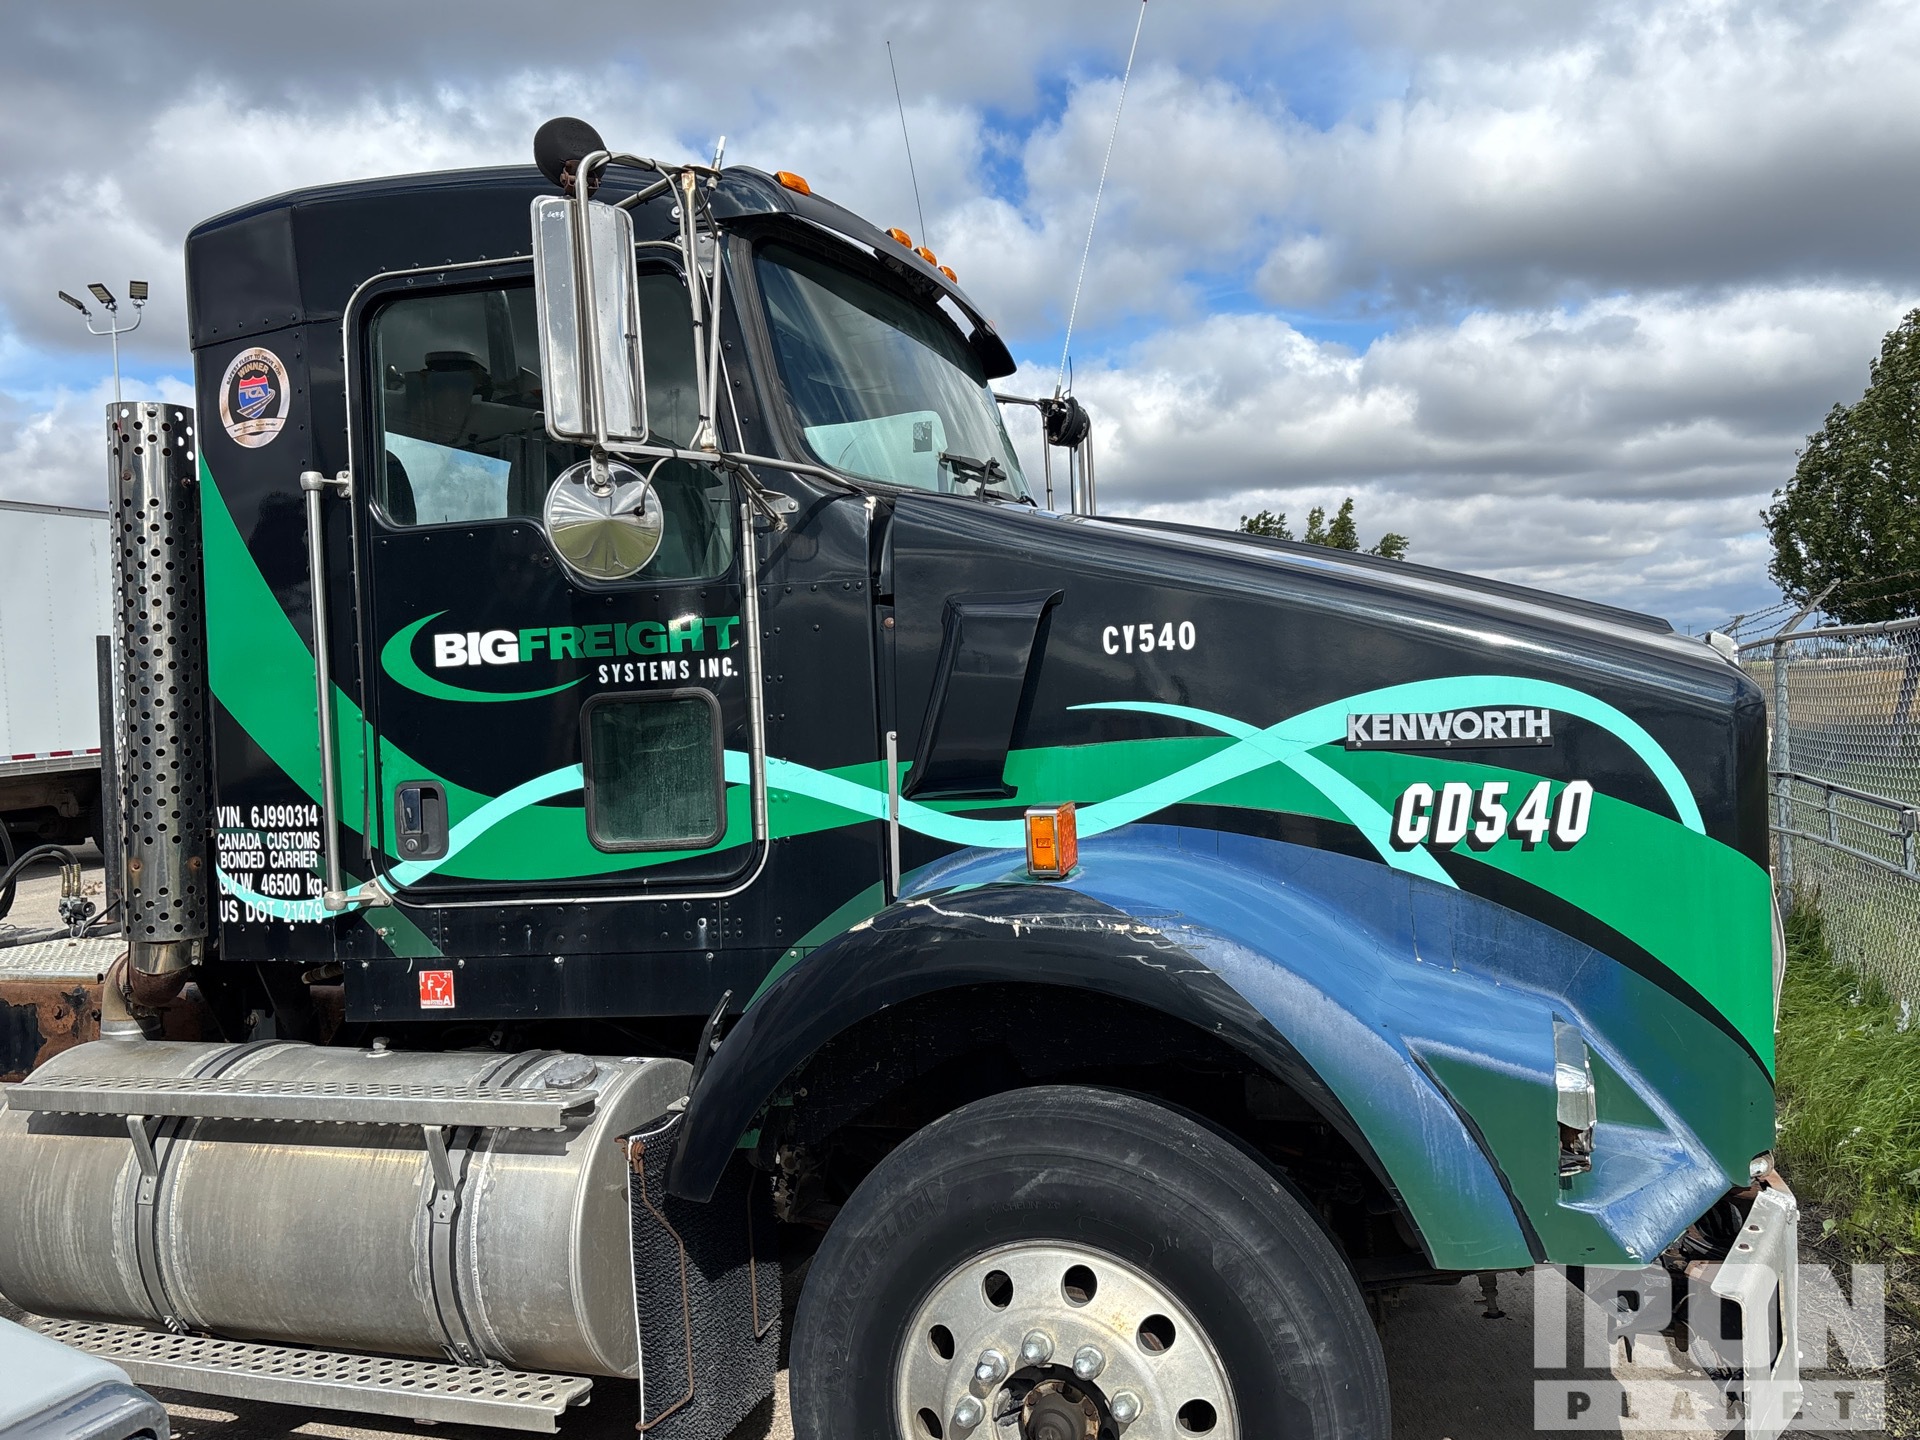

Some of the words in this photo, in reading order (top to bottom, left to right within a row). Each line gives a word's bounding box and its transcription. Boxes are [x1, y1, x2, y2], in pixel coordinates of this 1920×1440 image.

[237, 361, 269, 378] WINNER
[239, 386, 266, 400] TCA
[1102, 620, 1197, 656] CY540
[598, 660, 690, 684] SYSTEMS
[699, 656, 739, 678] INC.
[1347, 708, 1550, 742] KENWORTH
[216, 805, 245, 828] VIN.
[251, 804, 318, 828] 6J990314
[1393, 780, 1594, 850] CD540
[217, 832, 262, 851] CANADA
[266, 831, 320, 850] CUSTOMS
[220, 851, 265, 869] BONDED
[269, 850, 318, 869] CARRIER
[219, 872, 255, 896] G.V.W.
[260, 873, 301, 896] 46500
[219, 900, 239, 923] US
[245, 900, 276, 923] DOT
[283, 901, 323, 924] 21479
[991, 1200, 1040, 1215] MICHELIN
